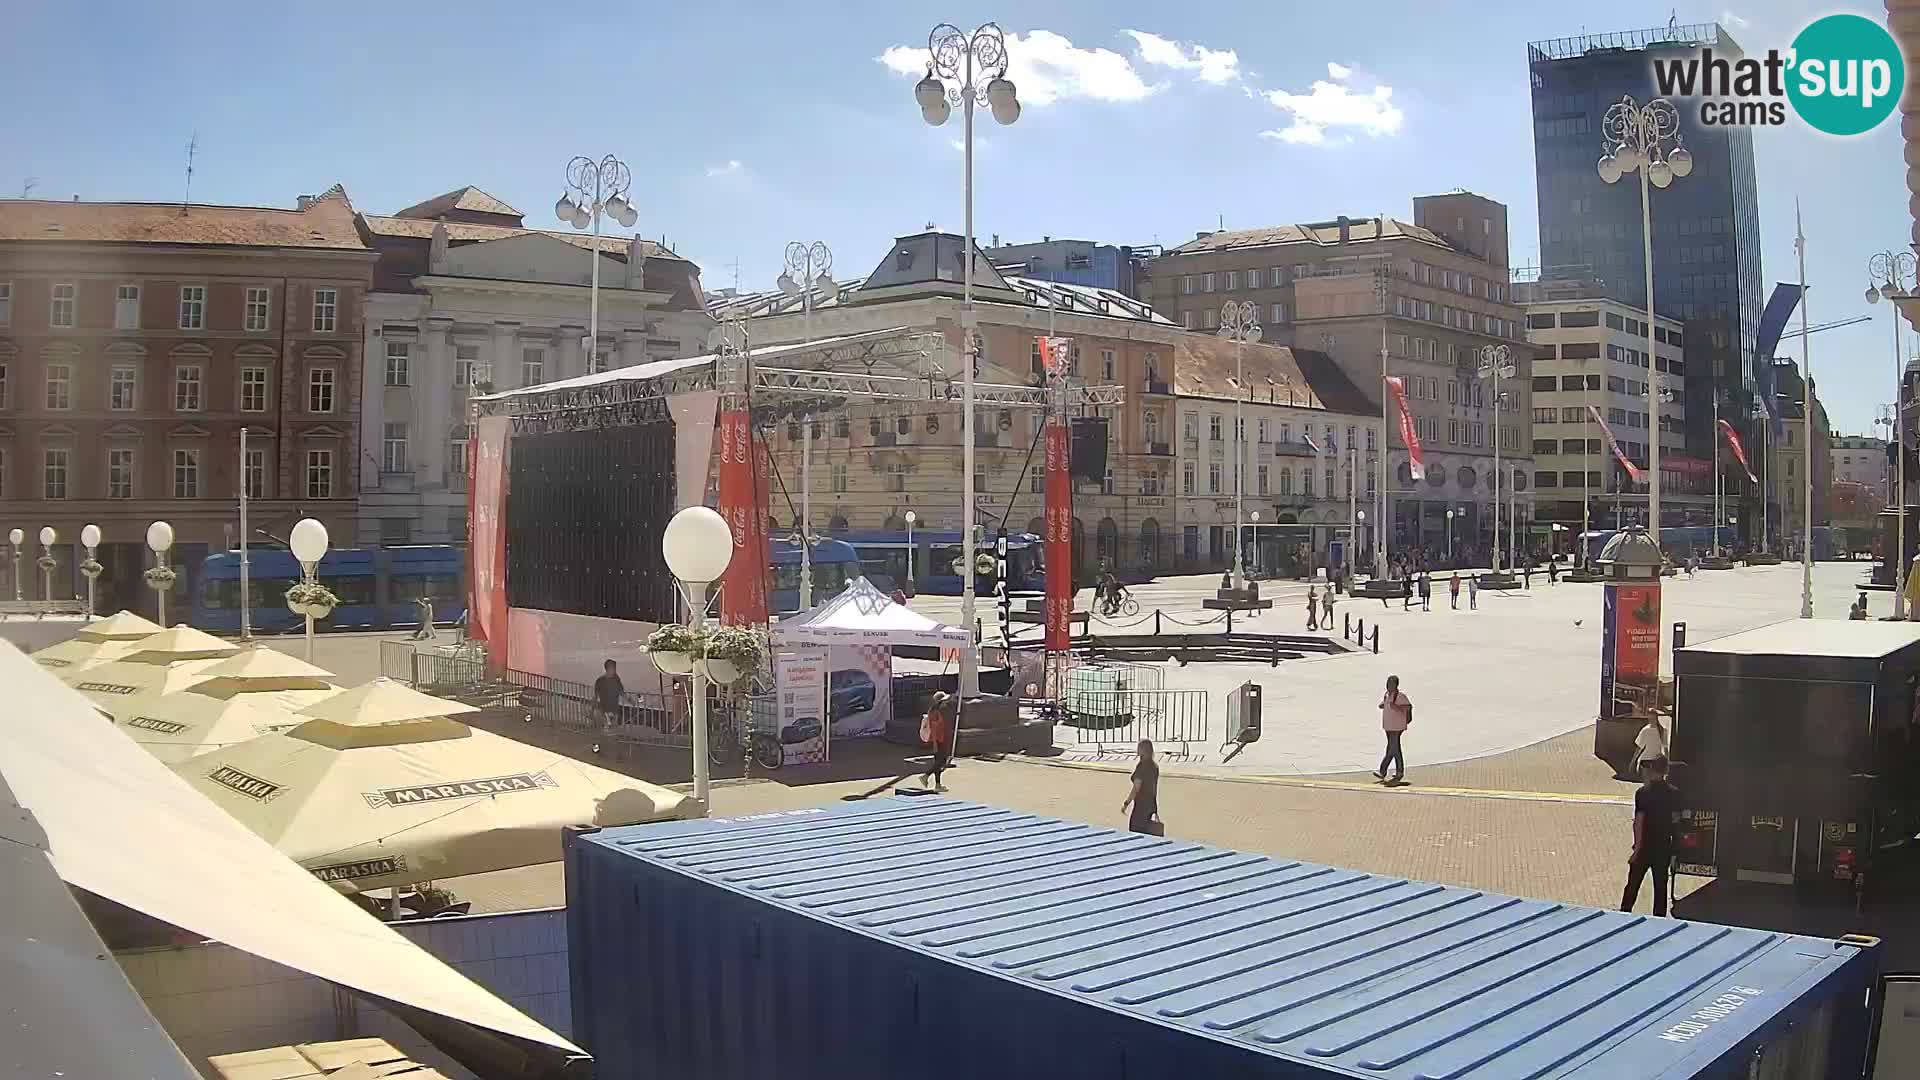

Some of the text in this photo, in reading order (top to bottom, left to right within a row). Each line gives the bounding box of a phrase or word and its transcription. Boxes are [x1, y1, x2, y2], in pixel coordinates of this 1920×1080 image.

[214, 767, 273, 798] MARASKA
[395, 777, 529, 803] MARASKA
[315, 860, 393, 881] MARASKA
